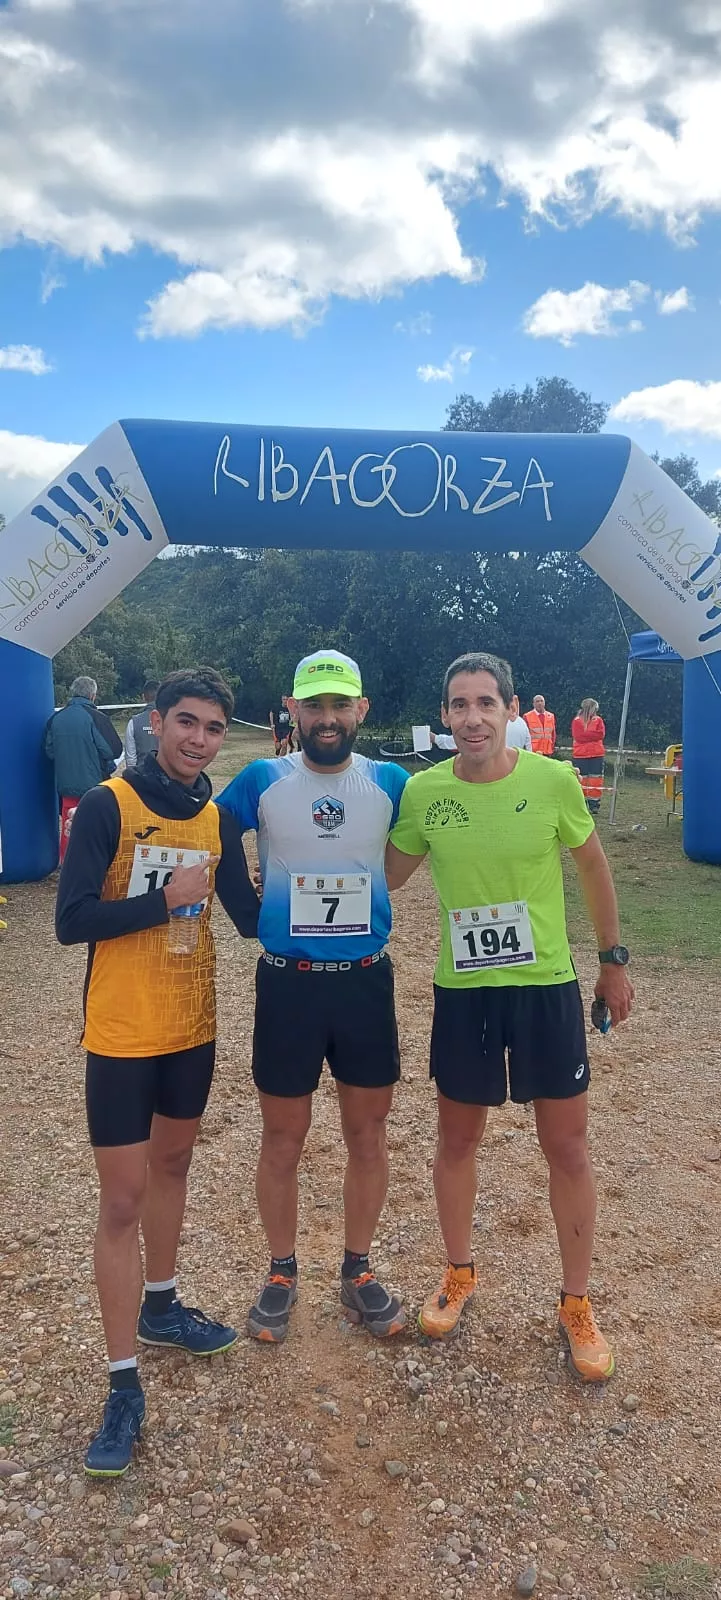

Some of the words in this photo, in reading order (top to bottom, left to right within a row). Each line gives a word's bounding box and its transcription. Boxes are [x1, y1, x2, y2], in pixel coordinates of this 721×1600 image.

[212, 434, 555, 522] RIBAGORZA
[615, 514, 649, 548] comarca
[55, 588, 78, 611] servicio
[85, 556, 111, 582] deportes
[14, 598, 50, 632] comarca
[48, 587, 60, 600] de
[57, 580, 69, 591] la
[424, 799, 442, 826] BOSTON
[443, 798, 470, 823] FINISHER
[321, 897, 340, 924] 7
[462, 926, 520, 957] 194
